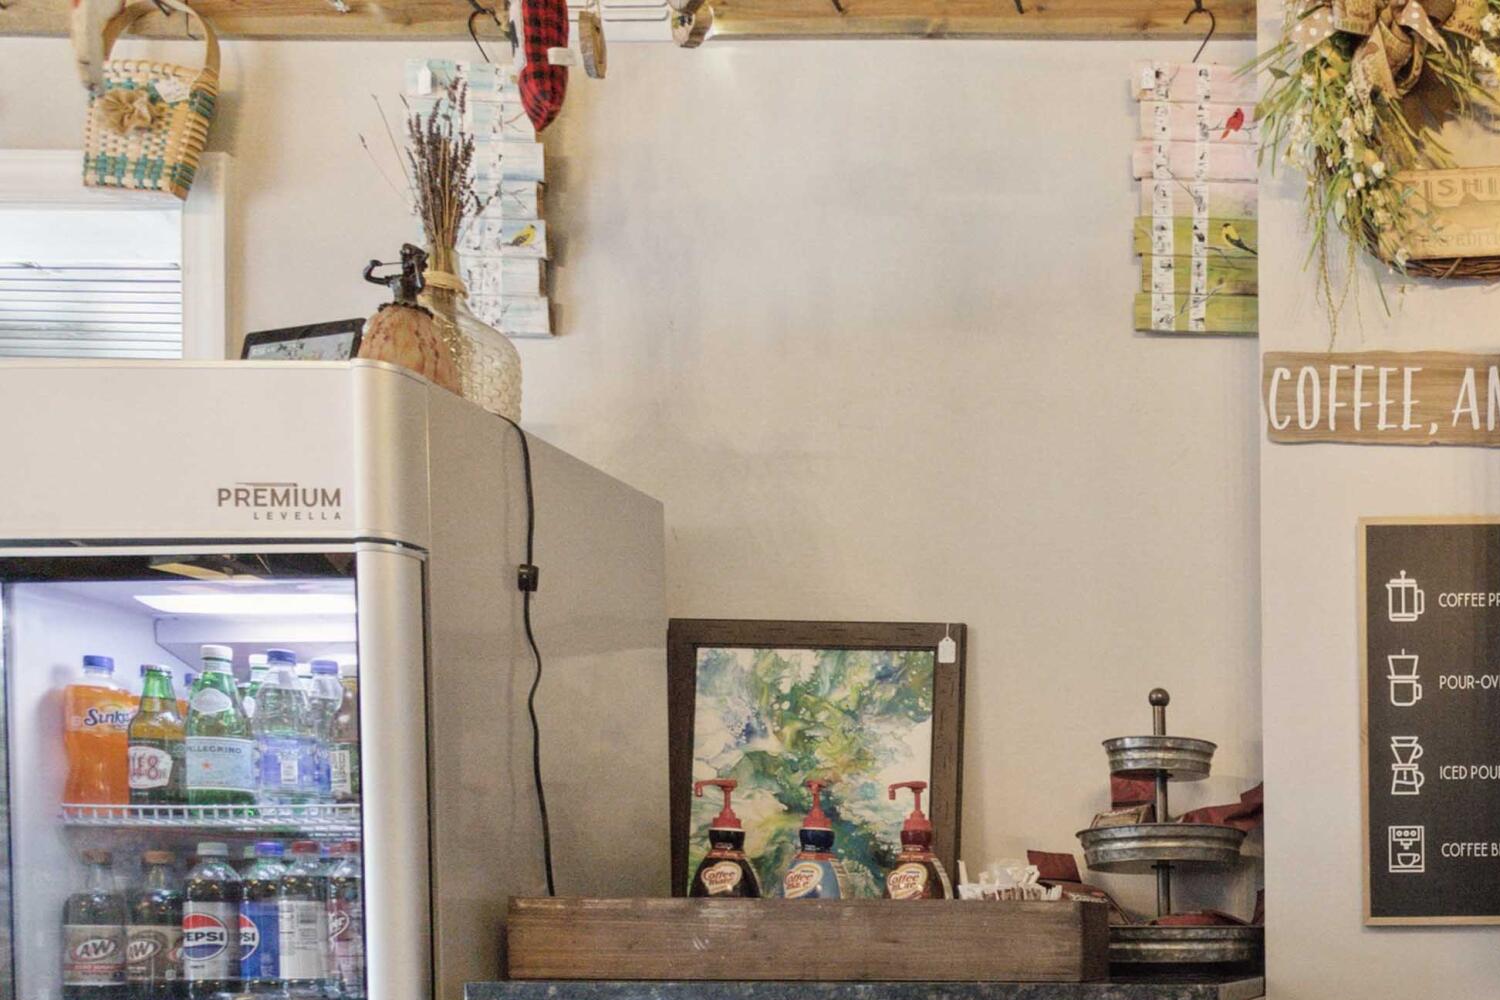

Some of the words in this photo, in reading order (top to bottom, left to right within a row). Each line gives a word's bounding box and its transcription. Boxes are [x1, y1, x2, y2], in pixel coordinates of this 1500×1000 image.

[1268, 364, 1438, 435] COFFEE,
[217, 487, 342, 507] PREMIUM
[253, 511, 342, 521] LEVELLA
[1438, 592, 1486, 607] COFFEE
[1439, 765, 1468, 780] ICED
[1441, 843, 1489, 857] COFFEE
[185, 932, 224, 942] EPSI
